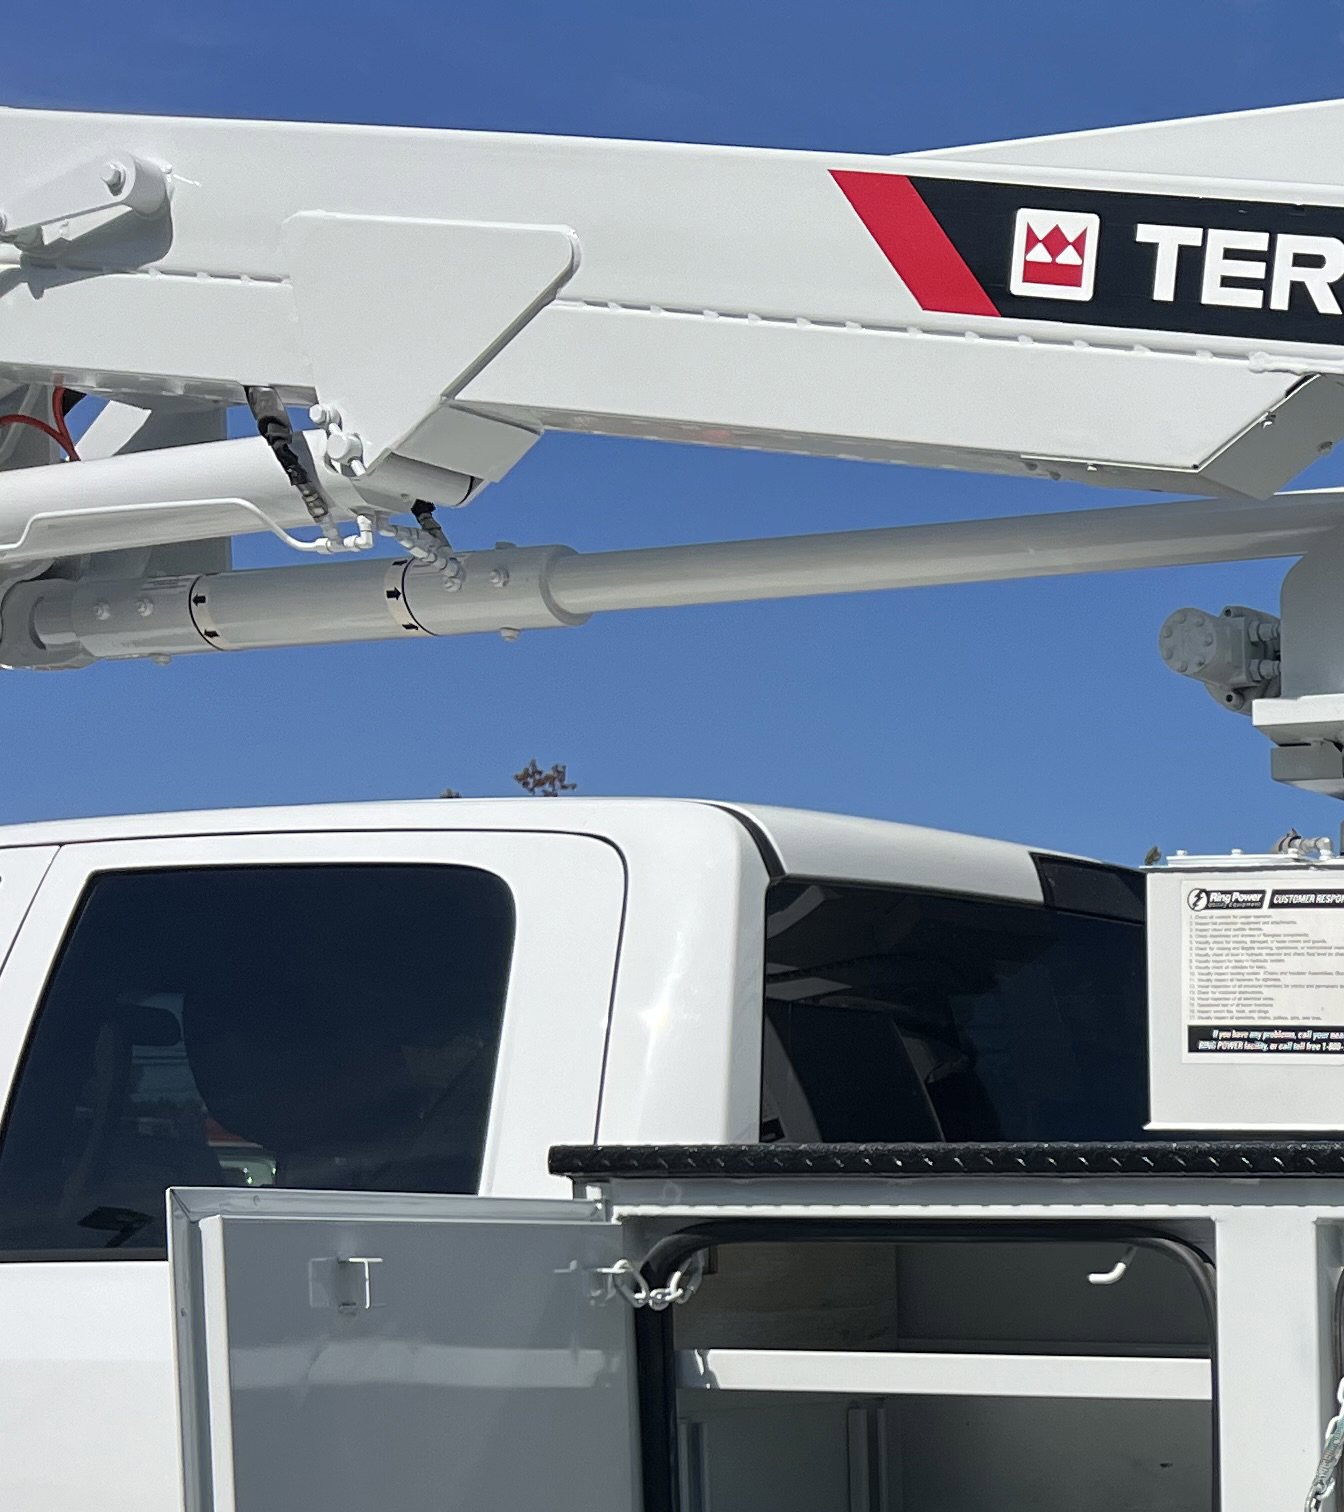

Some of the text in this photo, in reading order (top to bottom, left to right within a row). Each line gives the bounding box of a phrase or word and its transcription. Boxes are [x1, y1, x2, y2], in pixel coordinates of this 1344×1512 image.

[1210, 891, 1263, 905] Ring Power
[1273, 894, 1316, 904] CUSTOMER
[1217, 1041, 1244, 1050] POWER
